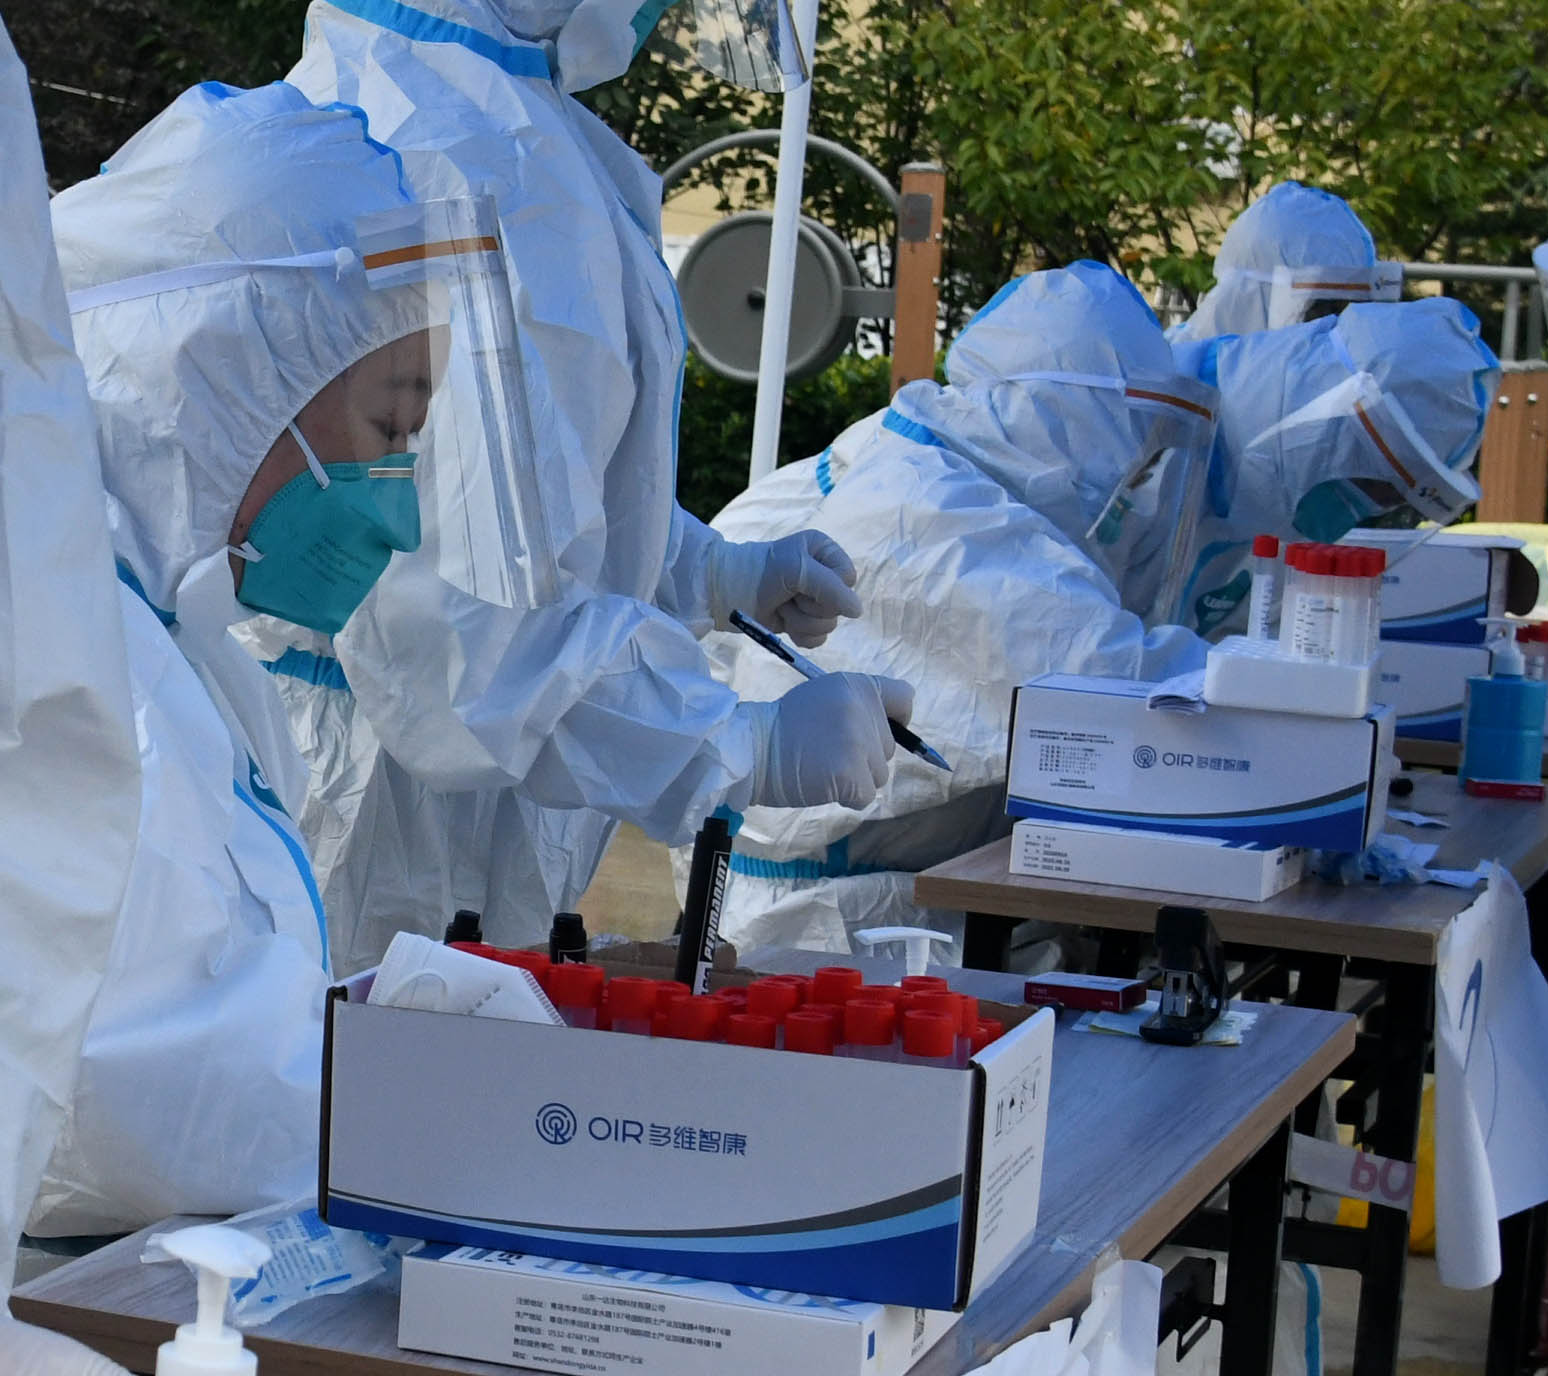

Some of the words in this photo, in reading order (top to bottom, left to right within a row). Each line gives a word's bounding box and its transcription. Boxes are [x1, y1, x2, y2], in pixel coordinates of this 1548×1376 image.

[1162, 752, 1194, 767] OIR
[588, 1116, 644, 1144] OIR
[649, 1123, 747, 1156] 多维智康
